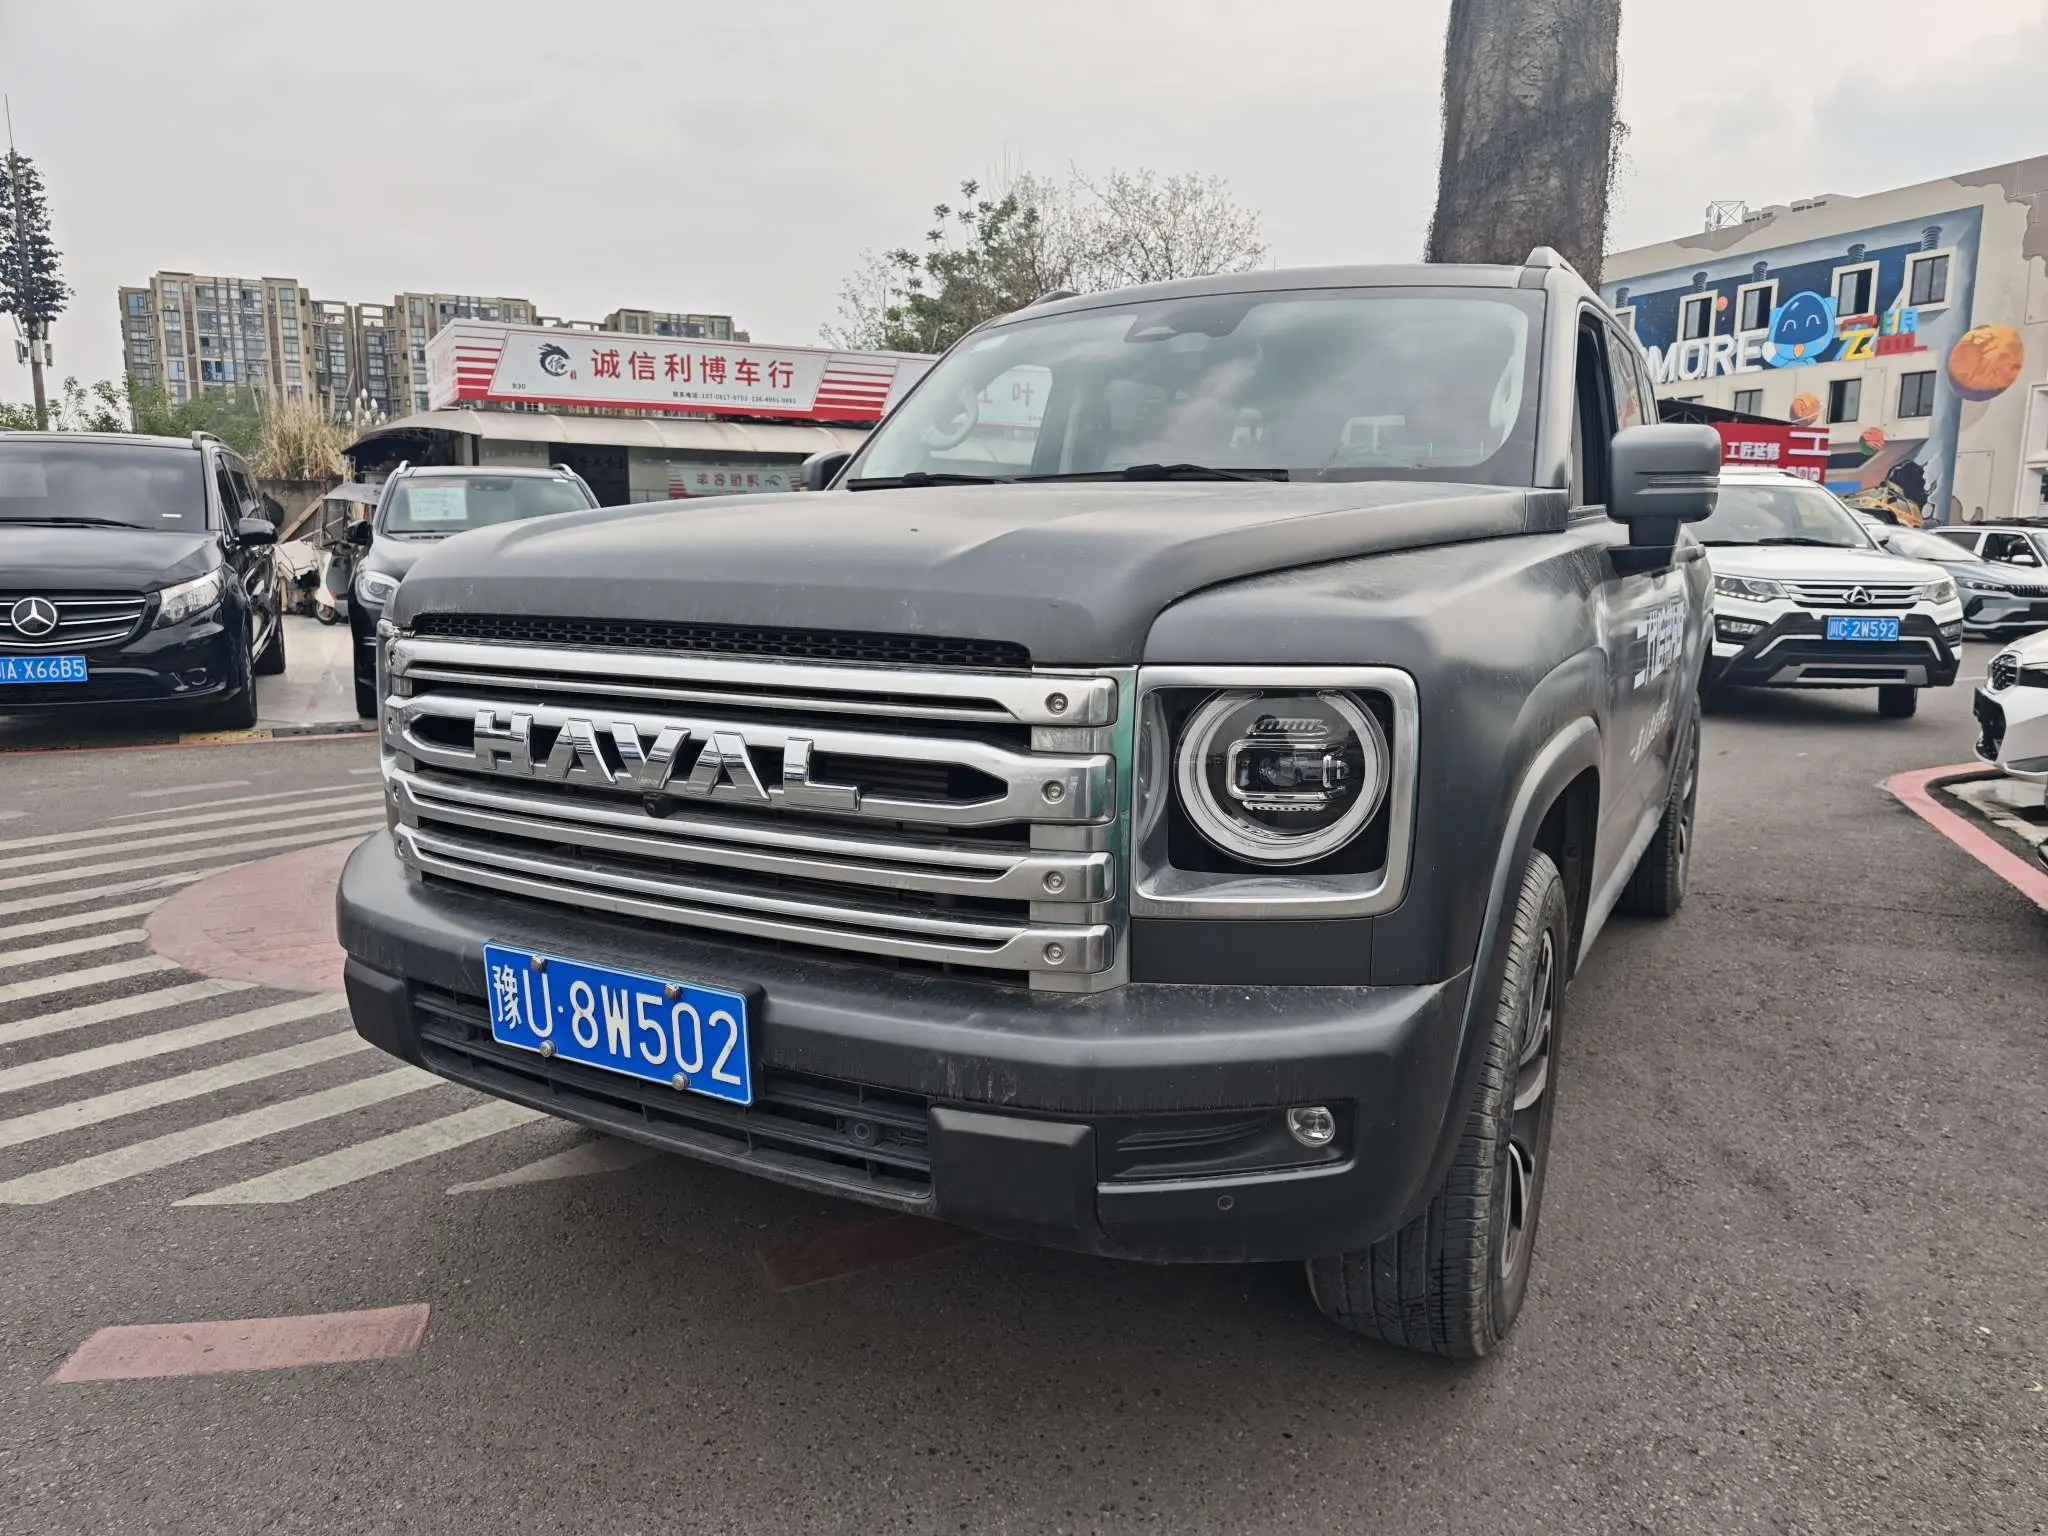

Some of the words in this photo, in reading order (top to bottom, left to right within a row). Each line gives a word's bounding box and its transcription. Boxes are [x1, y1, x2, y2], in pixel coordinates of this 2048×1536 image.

[591, 348, 794, 389] 诚信利博车行
[473, 708, 861, 812] HAVAL
